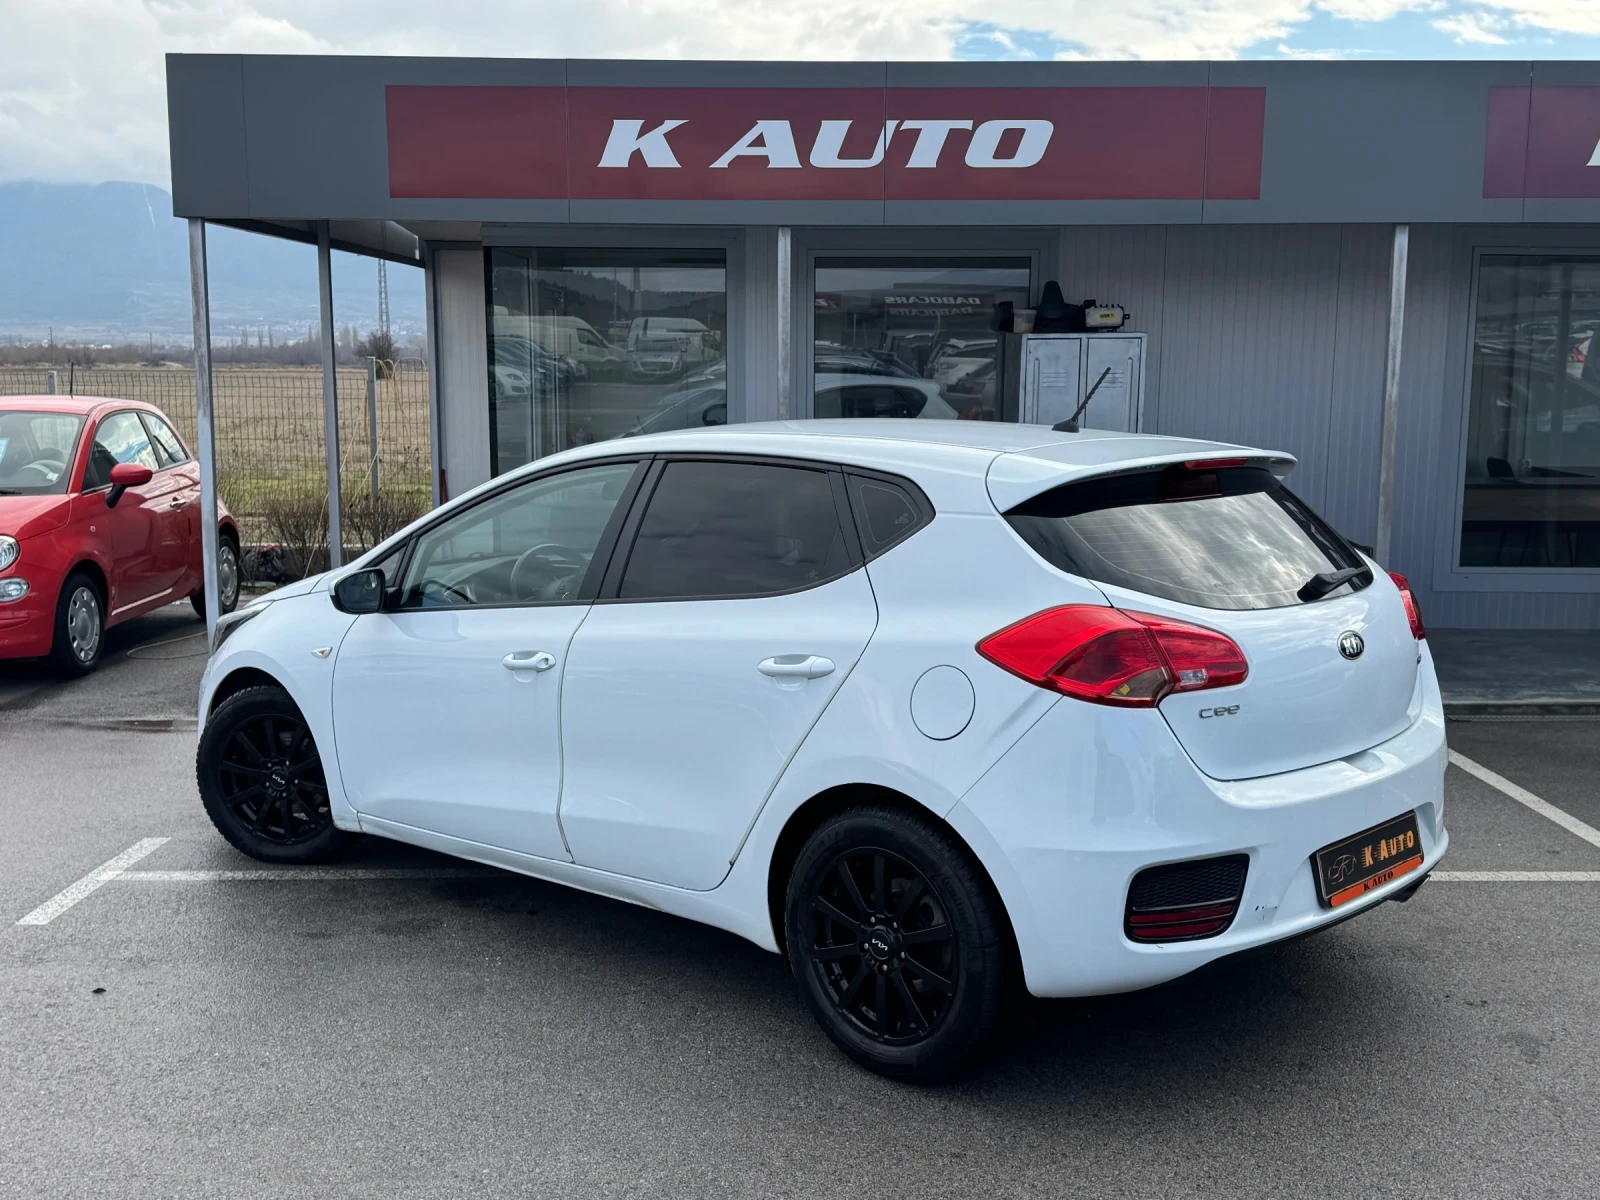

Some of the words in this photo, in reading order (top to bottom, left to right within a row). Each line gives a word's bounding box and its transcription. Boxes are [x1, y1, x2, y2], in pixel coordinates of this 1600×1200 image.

[597, 119, 690, 168] K
[708, 119, 1055, 169] AUTO
[1362, 845, 1374, 867] K
[1379, 830, 1415, 861] AUTO
[1363, 881, 1371, 892] K
[1372, 870, 1394, 887] AUTO
